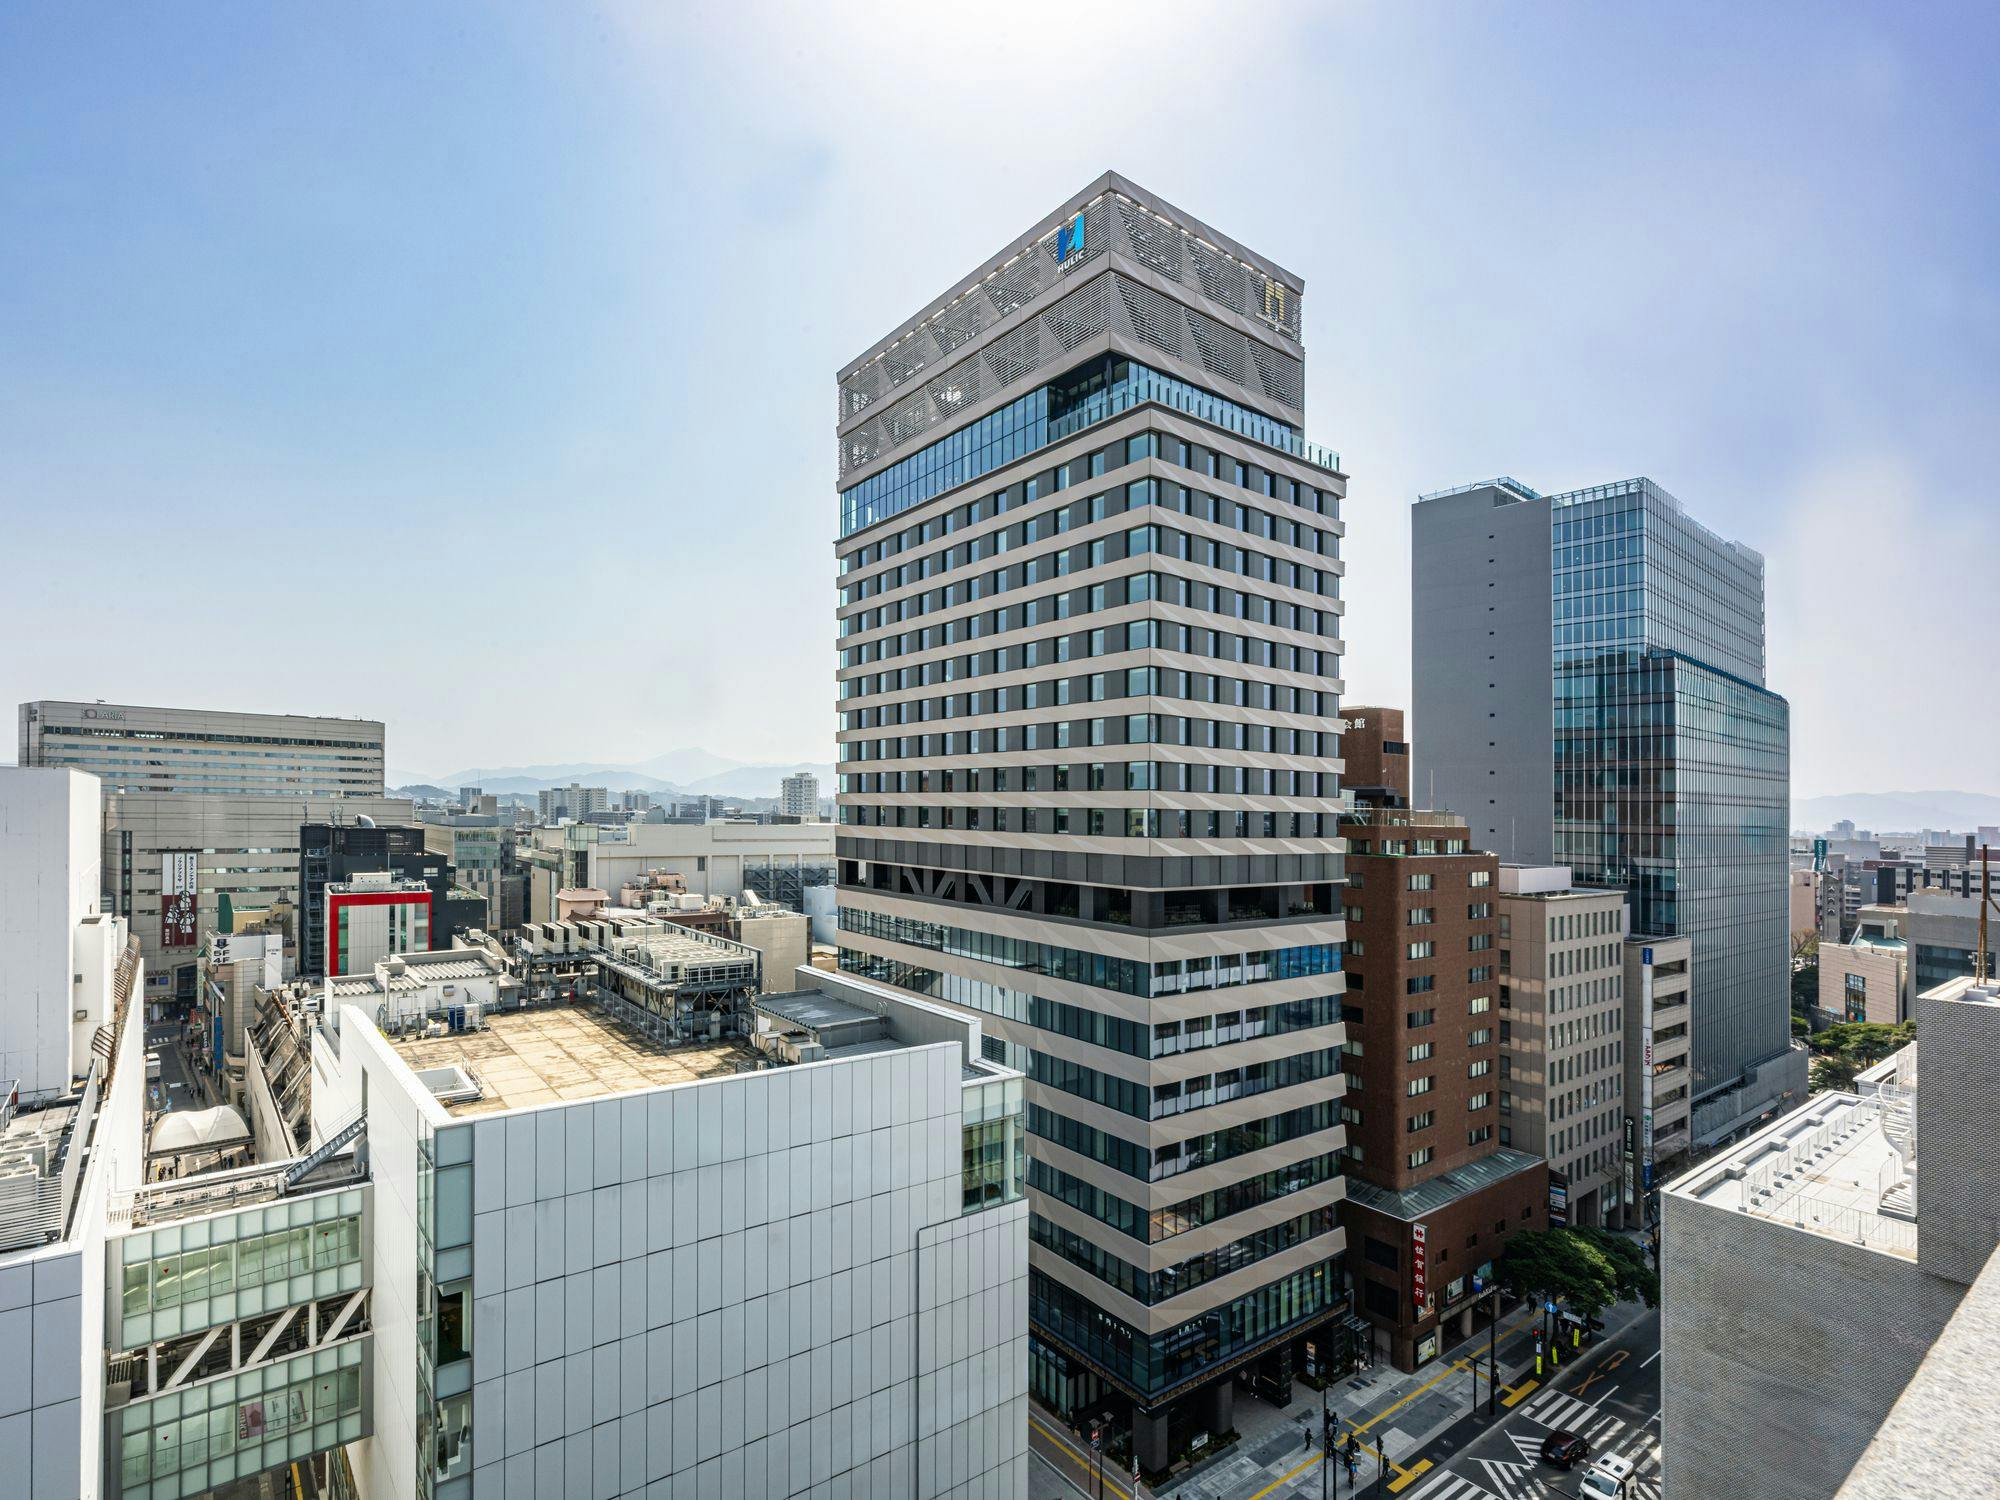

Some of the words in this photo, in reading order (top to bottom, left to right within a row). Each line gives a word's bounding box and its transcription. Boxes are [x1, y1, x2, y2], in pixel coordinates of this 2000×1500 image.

[1058, 250, 1084, 273] HULIC
[1414, 1245, 1425, 1299] 佐賀銀行
